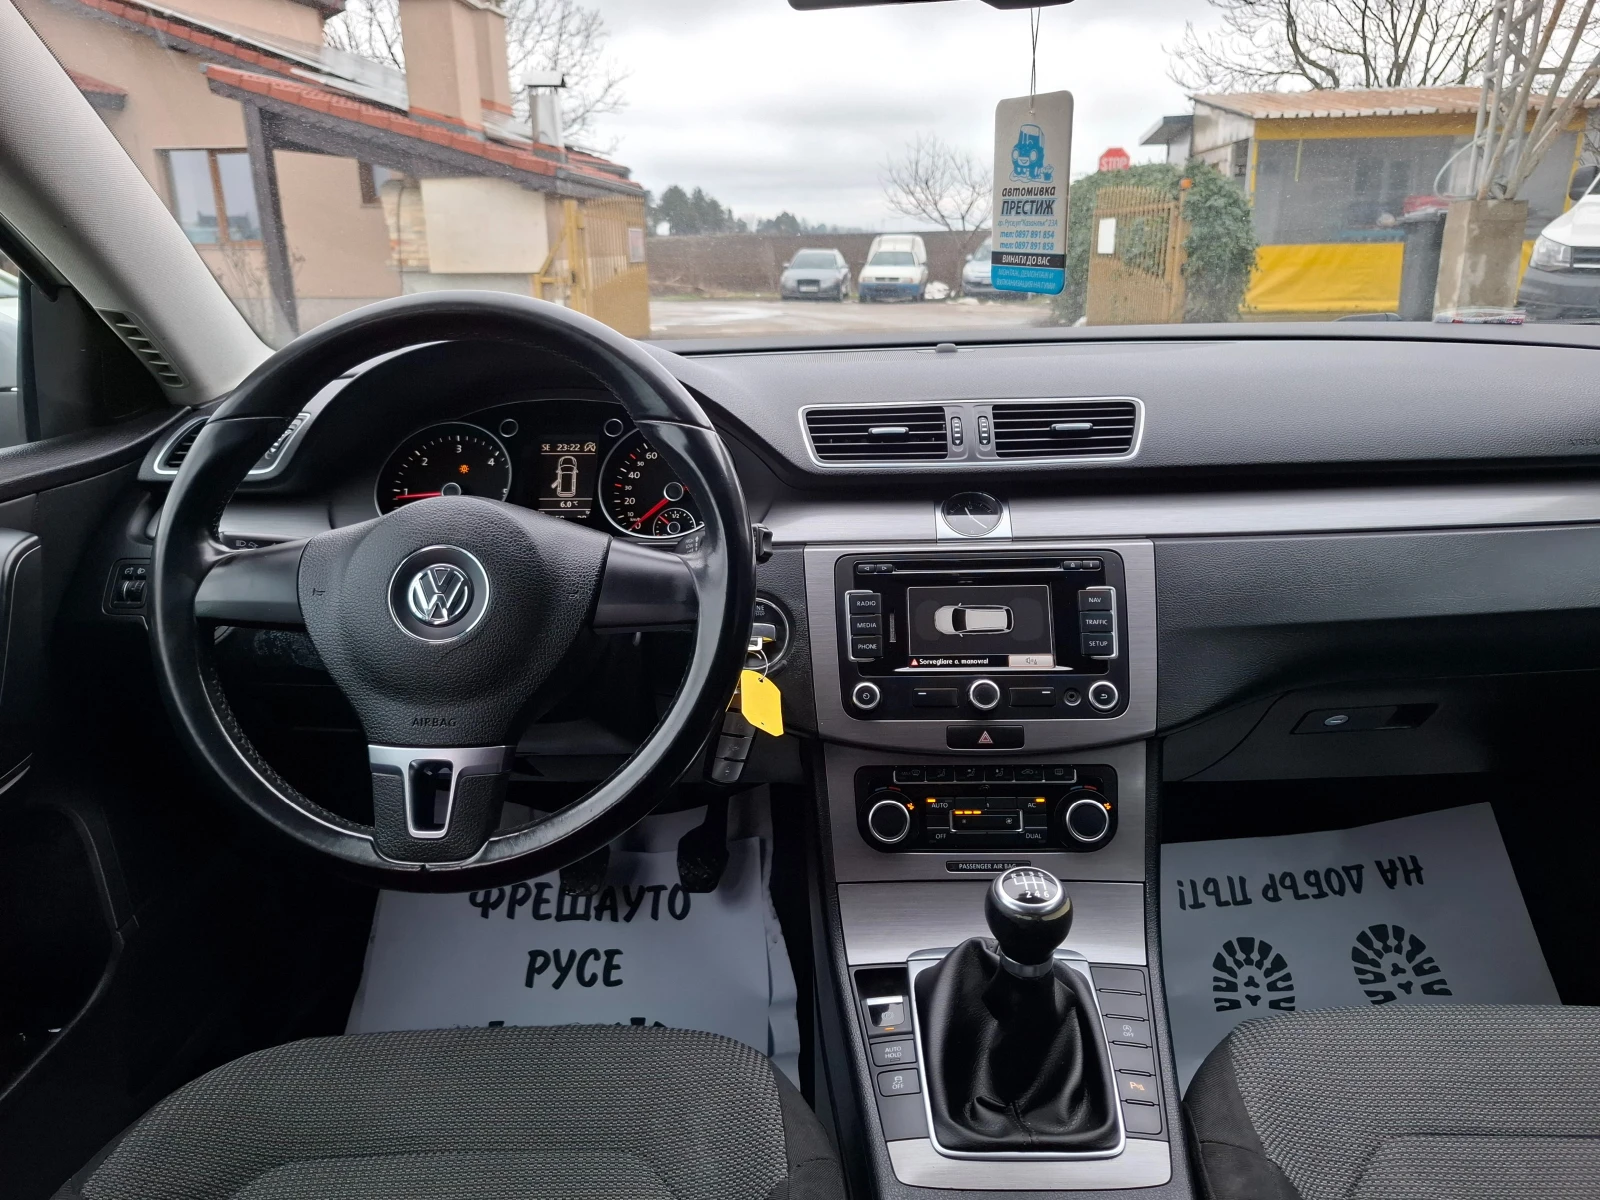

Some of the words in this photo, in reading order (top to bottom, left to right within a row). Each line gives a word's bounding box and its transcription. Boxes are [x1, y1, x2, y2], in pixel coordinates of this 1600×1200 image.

[1002, 186, 1056, 197] автомивка
[1001, 200, 1056, 215] ПРЕСТИЖ
[1030, 242, 1040, 250] 891
[1002, 255, 1026, 264] ВИНАГИ
[1026, 256, 1036, 265] ДО
[1038, 257, 1050, 265] ВАС
[456, 445, 462, 453] 3
[422, 458, 428, 466] 2
[412, 717, 457, 727] AIRBAG
[1374, 855, 1424, 890] НА
[1262, 864, 1365, 902] ДОБЪР
[1176, 875, 1252, 911] ПЪТ!
[525, 948, 624, 990] РУСЕ
